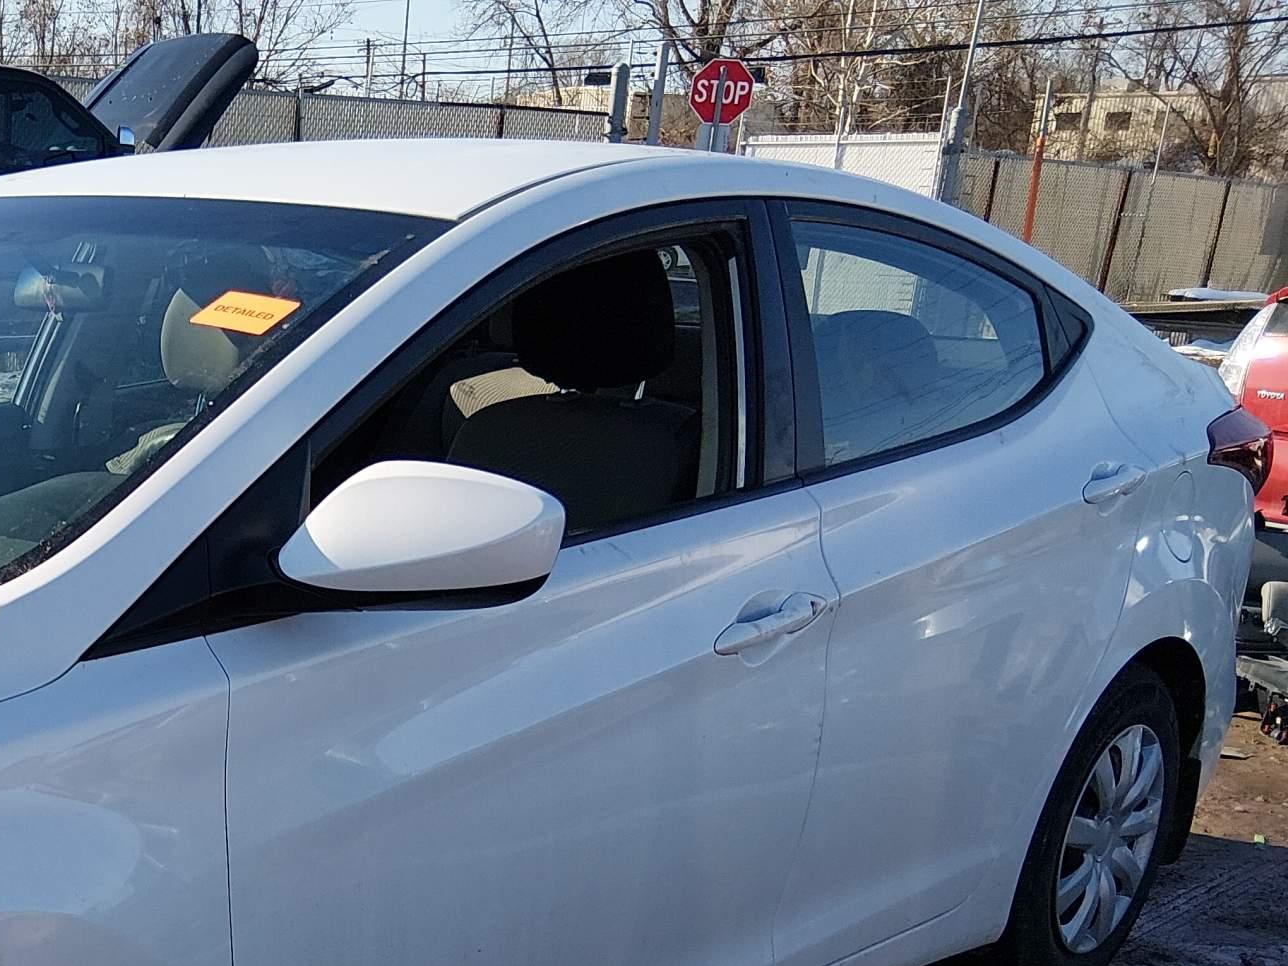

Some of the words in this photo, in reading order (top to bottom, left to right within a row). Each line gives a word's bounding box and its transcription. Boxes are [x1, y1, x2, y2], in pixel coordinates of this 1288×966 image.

[694, 79, 749, 105] STOP
[213, 304, 276, 321] DETAILED
[1256, 390, 1286, 400] TOYOTA
